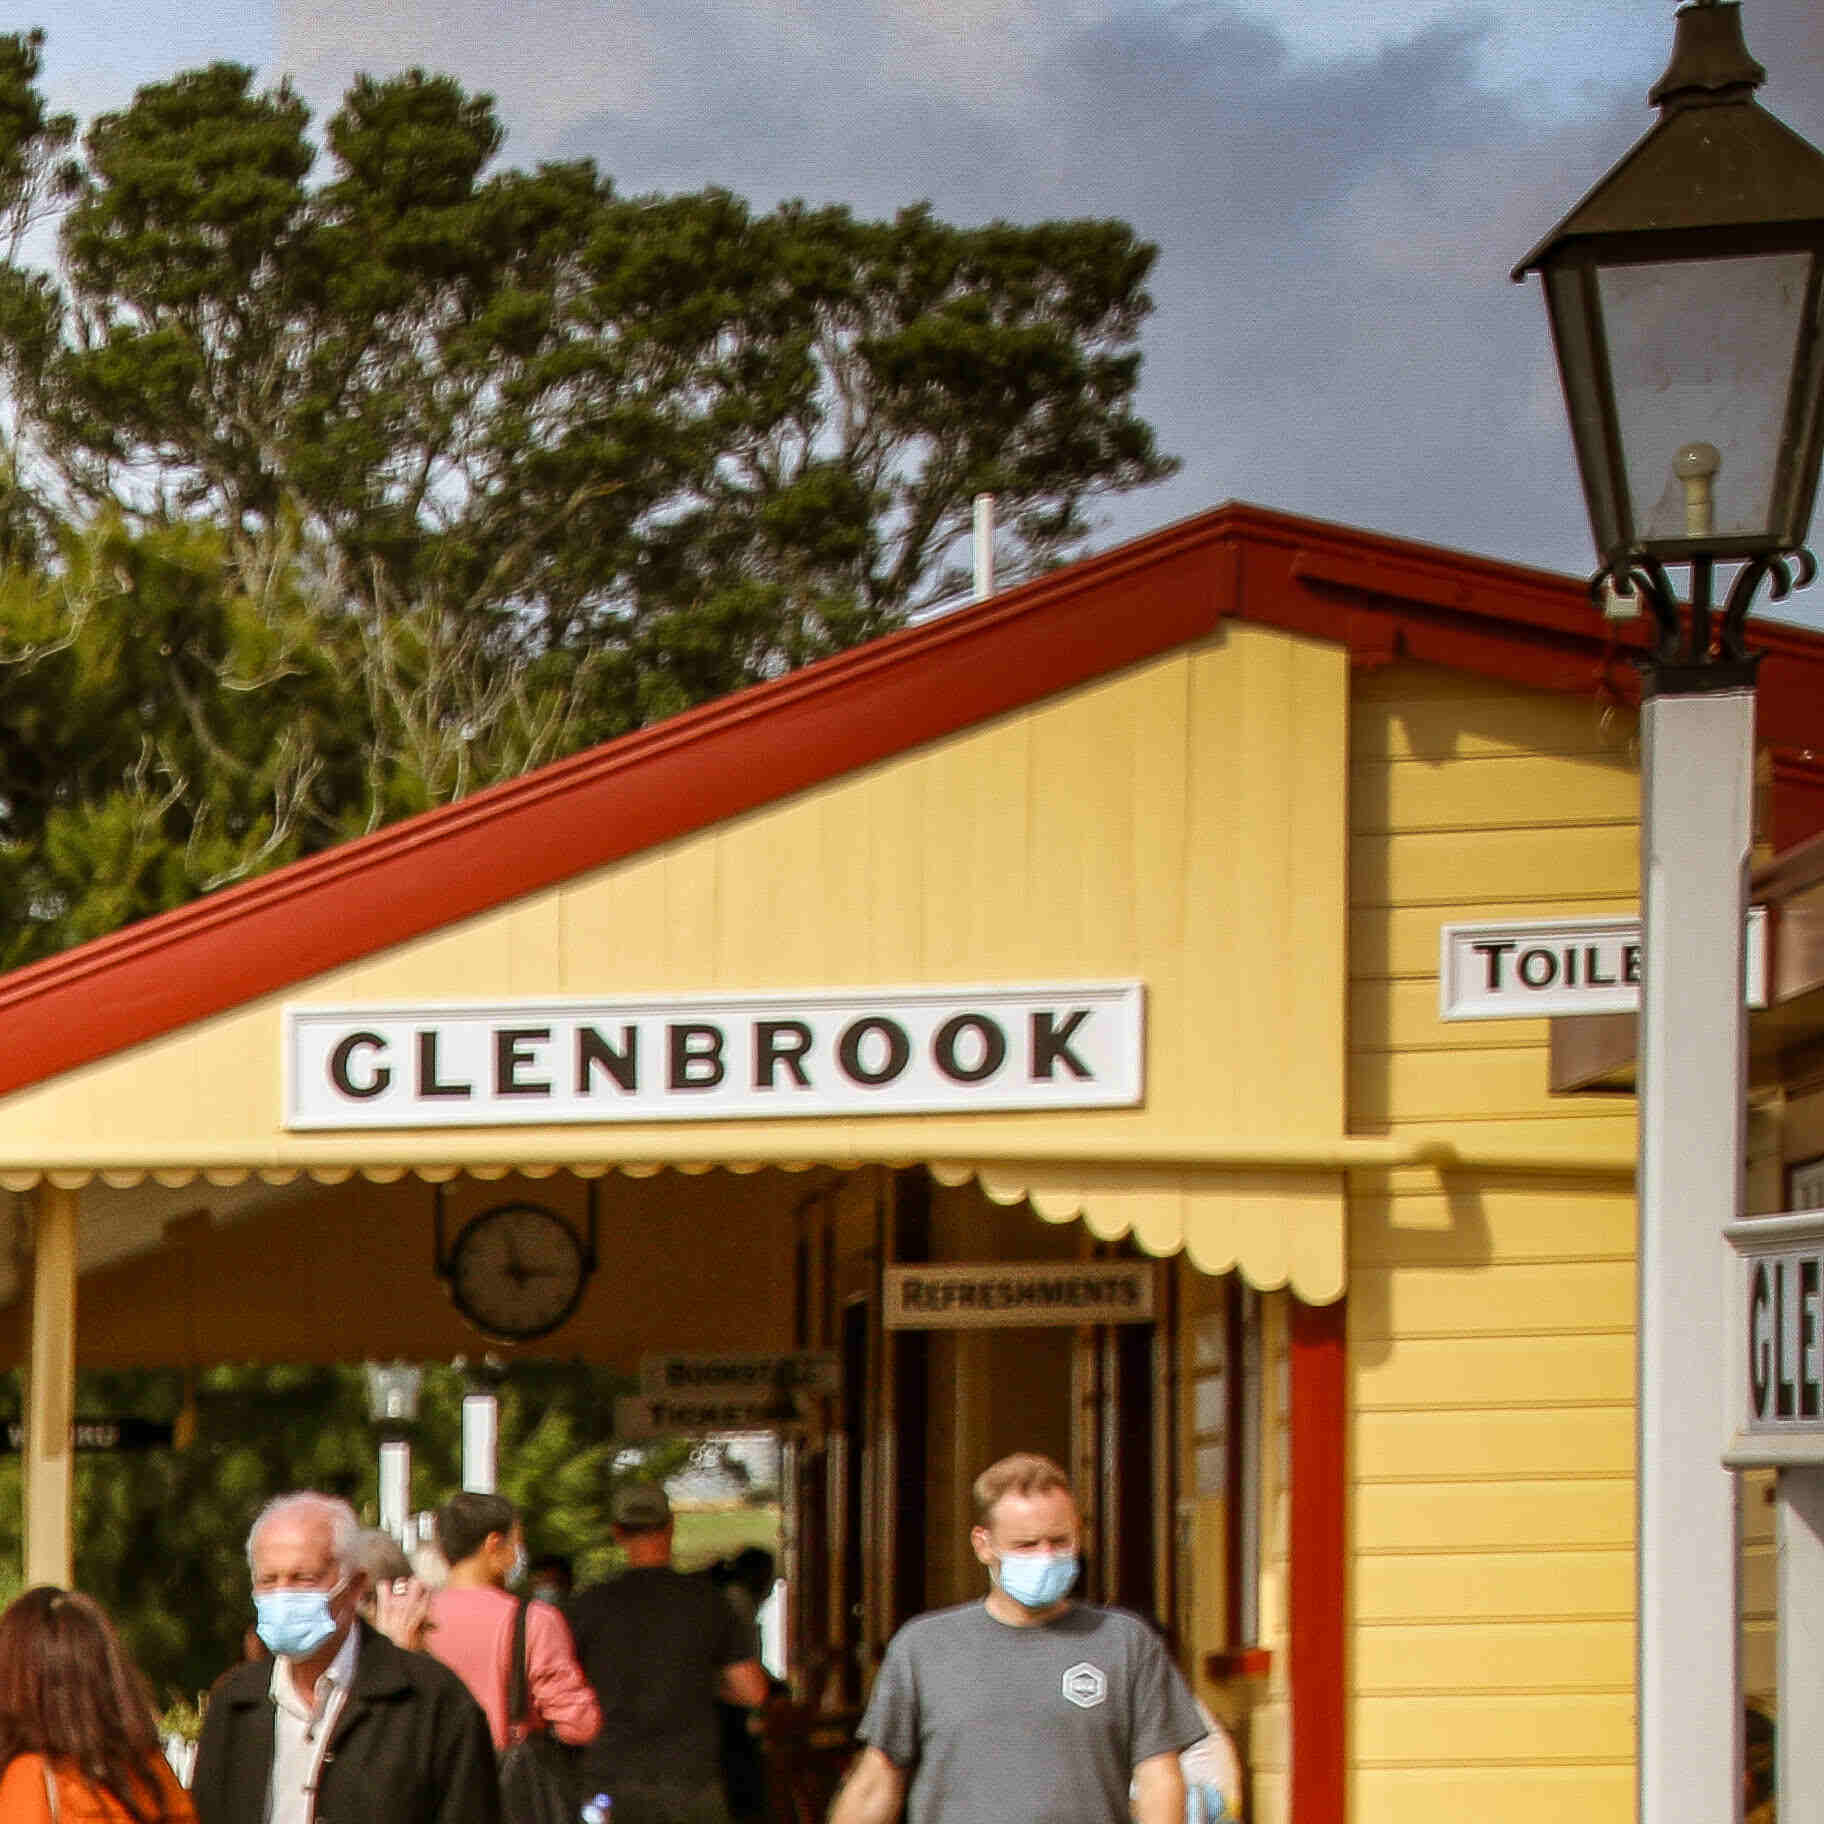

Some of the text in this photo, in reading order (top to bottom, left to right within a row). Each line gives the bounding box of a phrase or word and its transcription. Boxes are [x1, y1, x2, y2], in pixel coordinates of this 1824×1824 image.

[1472, 940, 1643, 994] TOILE
[325, 1008, 1093, 1101] GLENBROOK
[903, 1276, 1141, 1311] REFRESHMENTS
[1748, 1259, 1824, 1419] GLE
